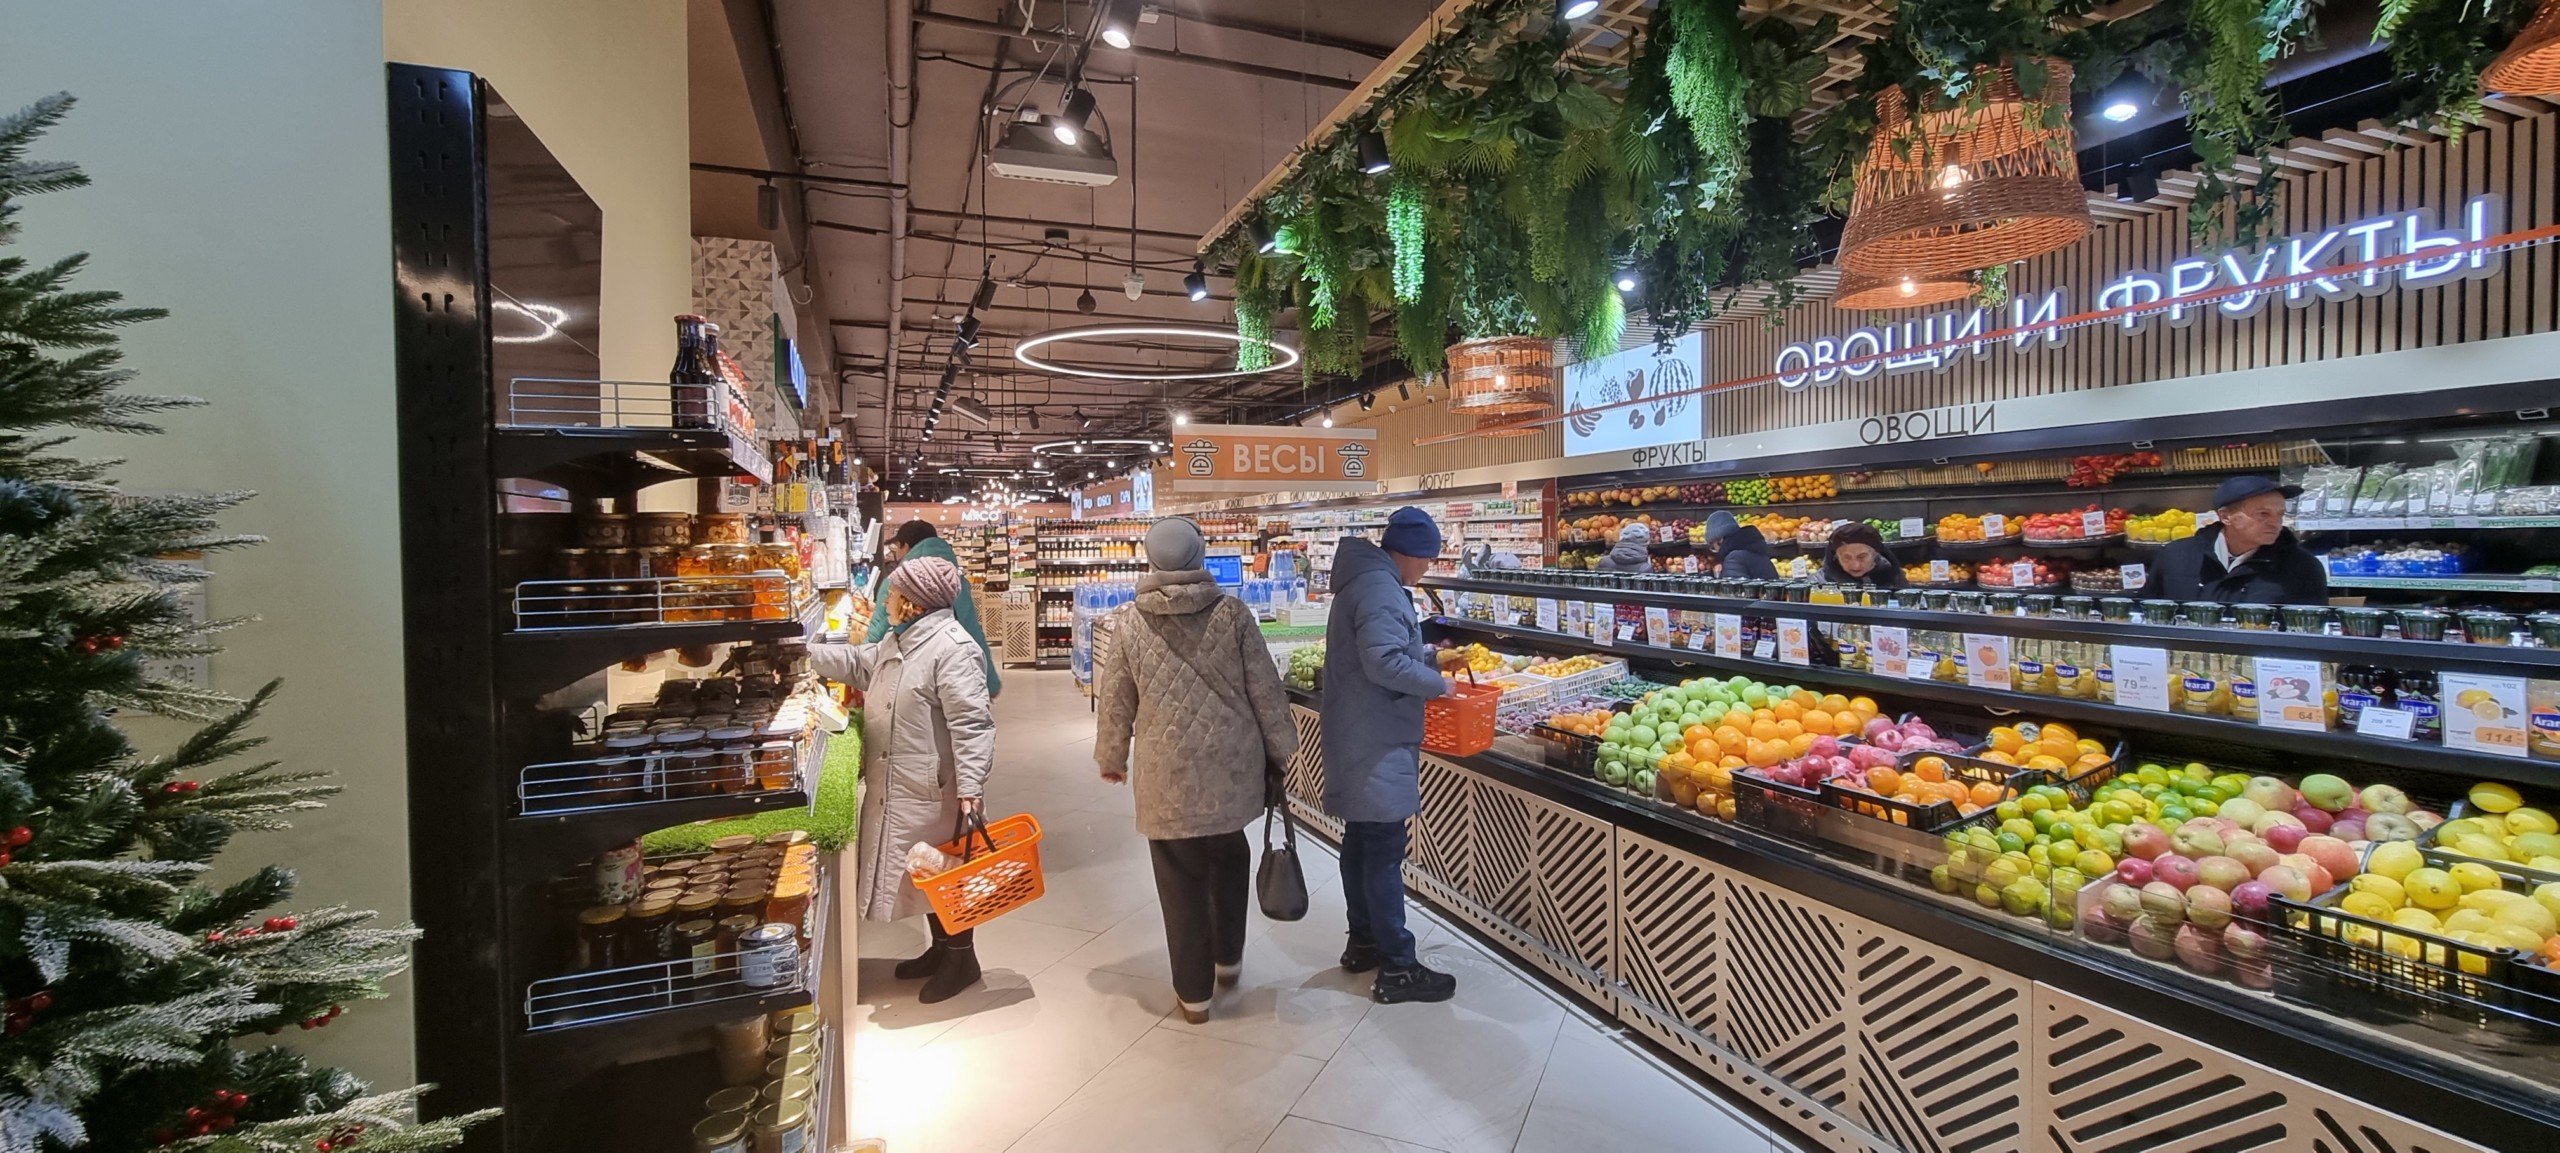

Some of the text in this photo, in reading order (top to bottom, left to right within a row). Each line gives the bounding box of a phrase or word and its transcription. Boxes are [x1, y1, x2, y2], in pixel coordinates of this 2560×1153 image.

[1775, 199, 2485, 390] ОВОЩИ И ФРУКТЫ
[1858, 403, 1996, 445] ОВОЩИ
[1233, 443, 1325, 475] ВЕСЫ
[1631, 440, 1708, 469] ФРУКТЫ
[1418, 471, 1455, 490] ЙОГУРТ
[2122, 678, 2138, 690] 79
[2184, 681, 2211, 692] Ararat
[2340, 696, 2372, 708] Ararat
[2534, 715, 2560, 729] Arar
[2485, 731, 2513, 744] 114
